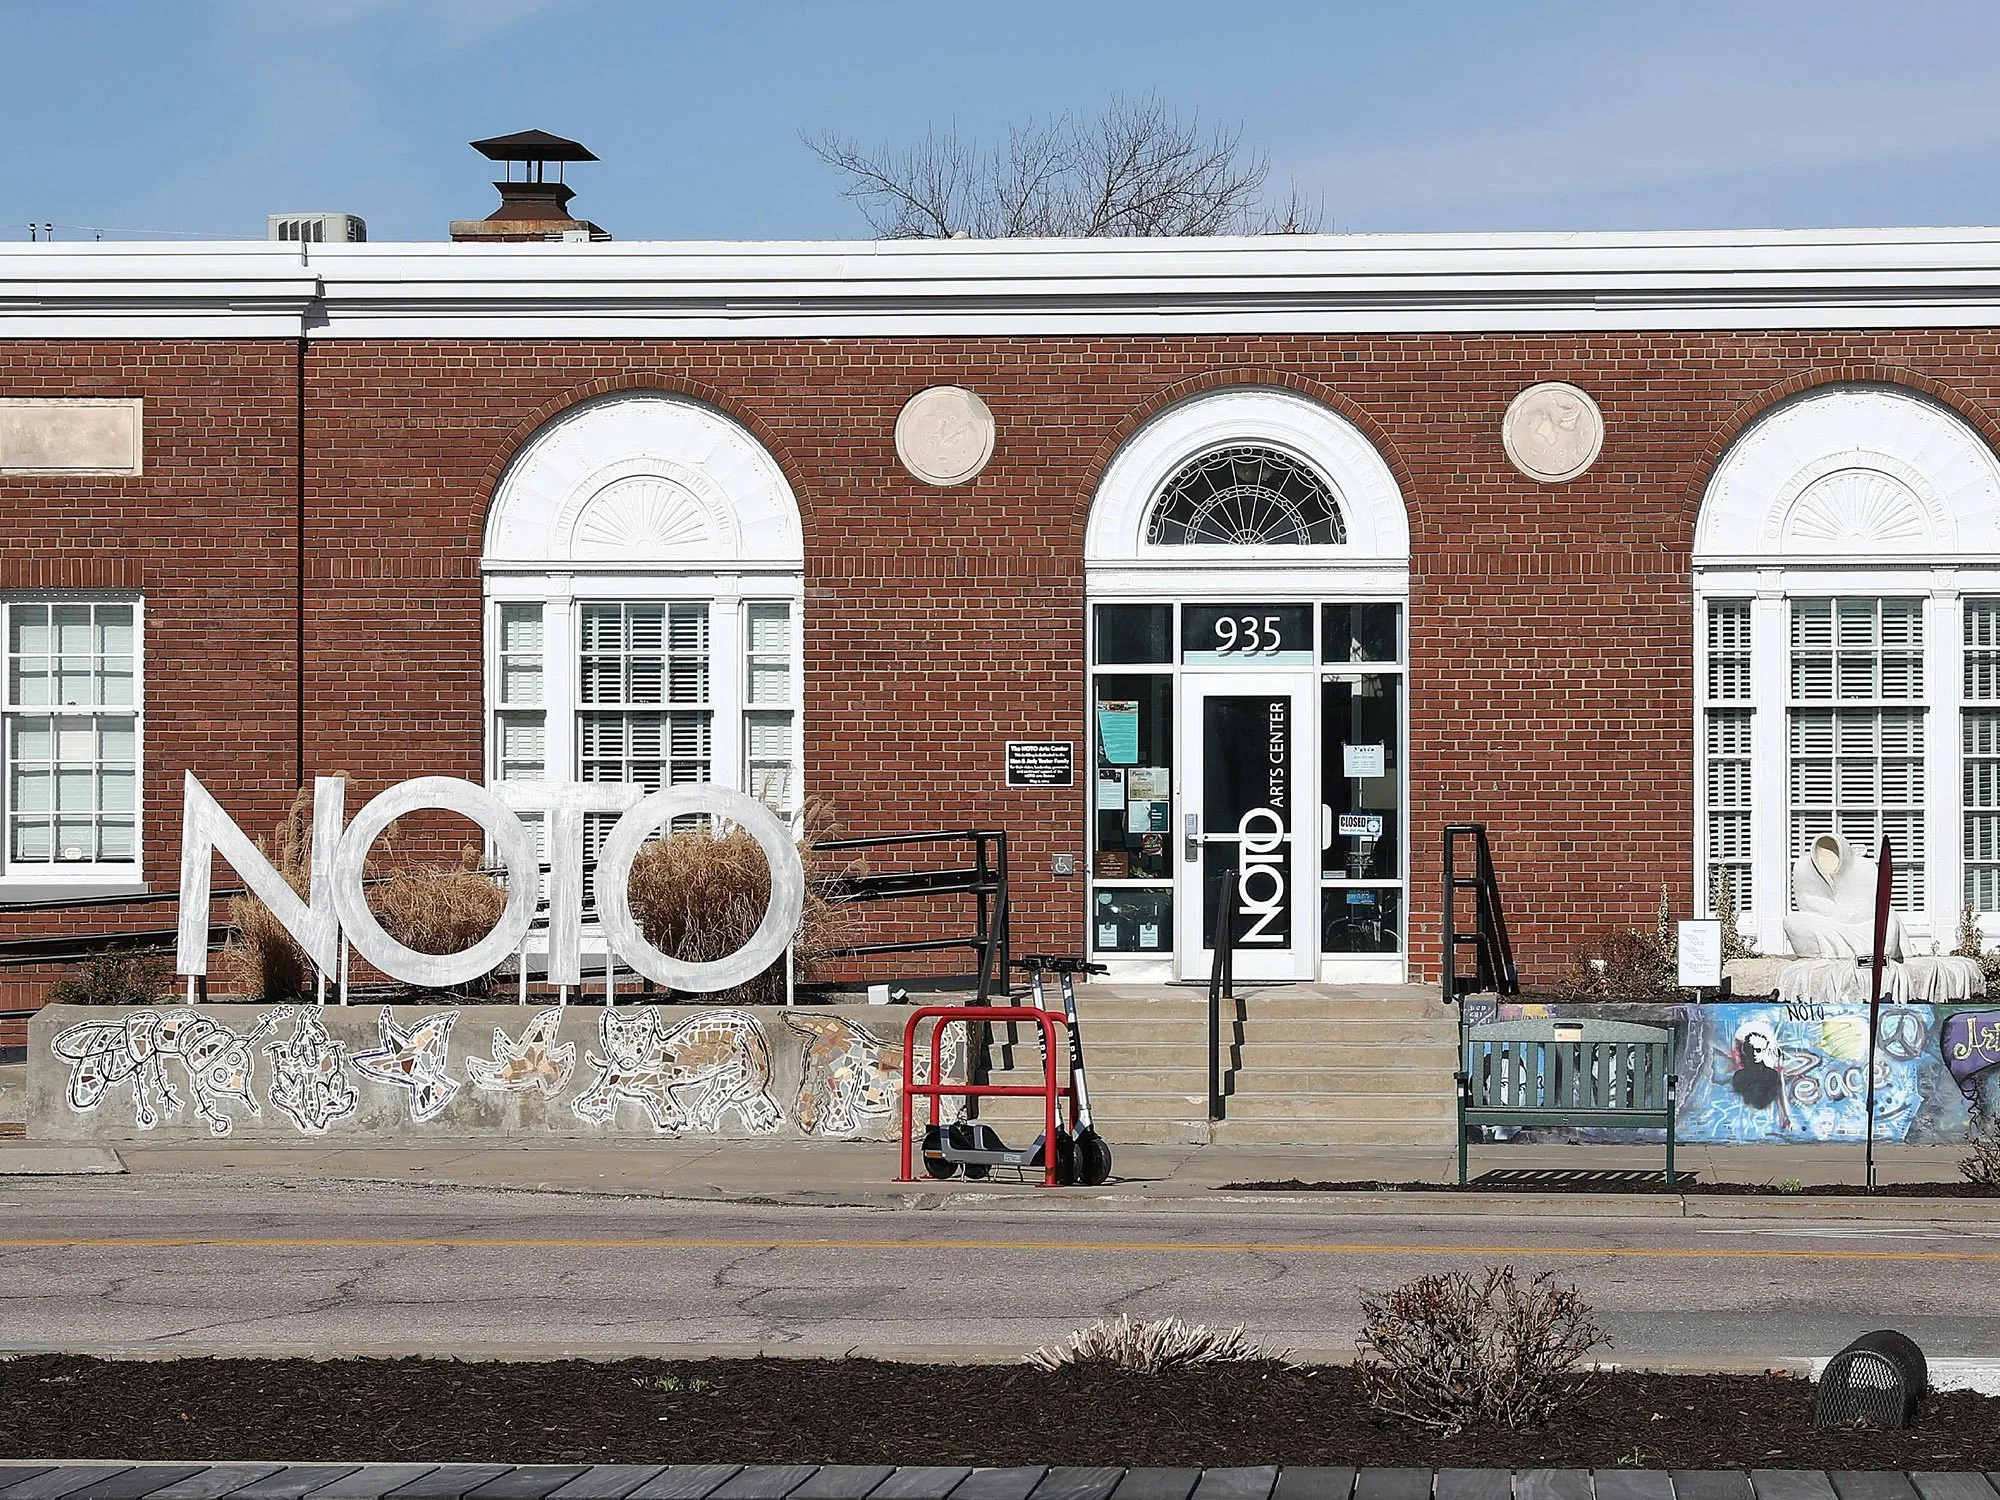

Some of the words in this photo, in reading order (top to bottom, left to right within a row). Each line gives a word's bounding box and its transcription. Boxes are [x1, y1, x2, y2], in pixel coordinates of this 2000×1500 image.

[1214, 616, 1281, 651] 935
[1269, 702, 1284, 764] CENTER
[1269, 768, 1284, 807] ARTS
[1340, 816, 1366, 828] CLOSED
[177, 769, 804, 993] NOTO
[1238, 807, 1285, 943] NOTO
[1786, 1003, 1824, 1021] NOTO
[1037, 1028, 1047, 1061] BIRD
[1067, 1029, 1077, 1062] BIRD
